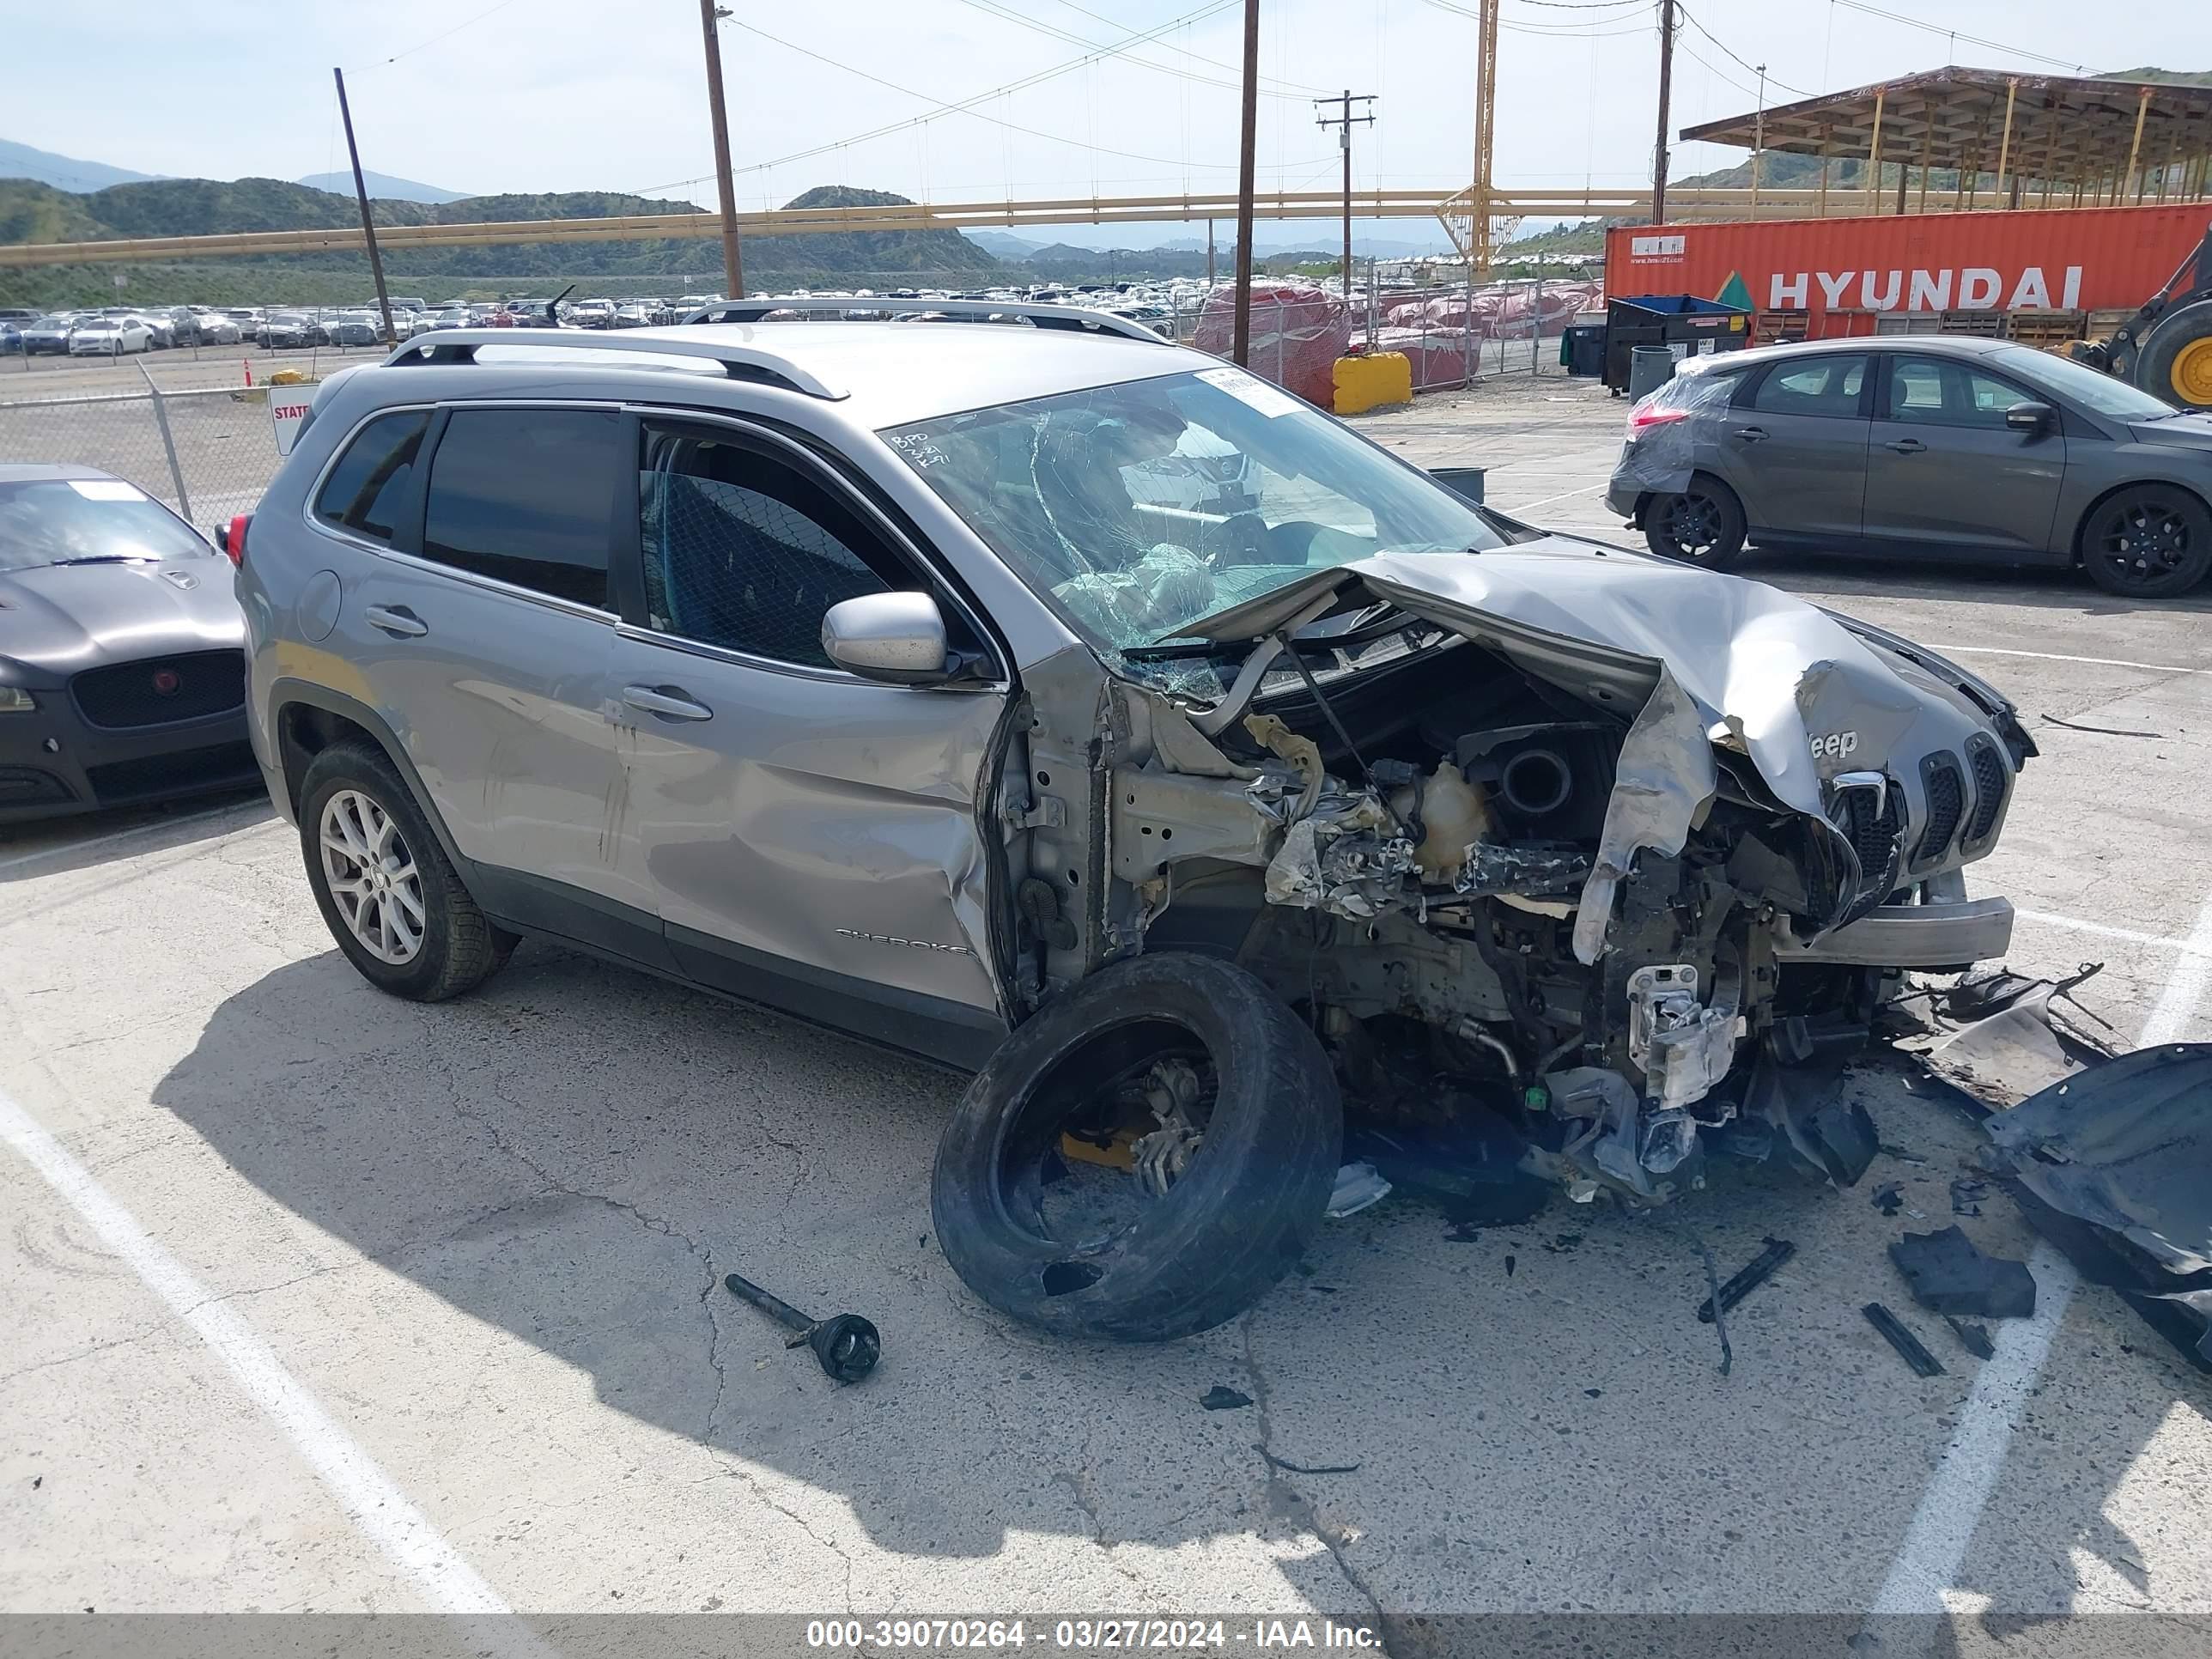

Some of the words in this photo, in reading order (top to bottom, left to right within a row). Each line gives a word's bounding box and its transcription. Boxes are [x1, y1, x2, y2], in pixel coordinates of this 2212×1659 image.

[1769, 266, 2082, 311] HYUNDAI
[891, 434, 927, 448] BPD
[1808, 732, 1857, 758] eep
